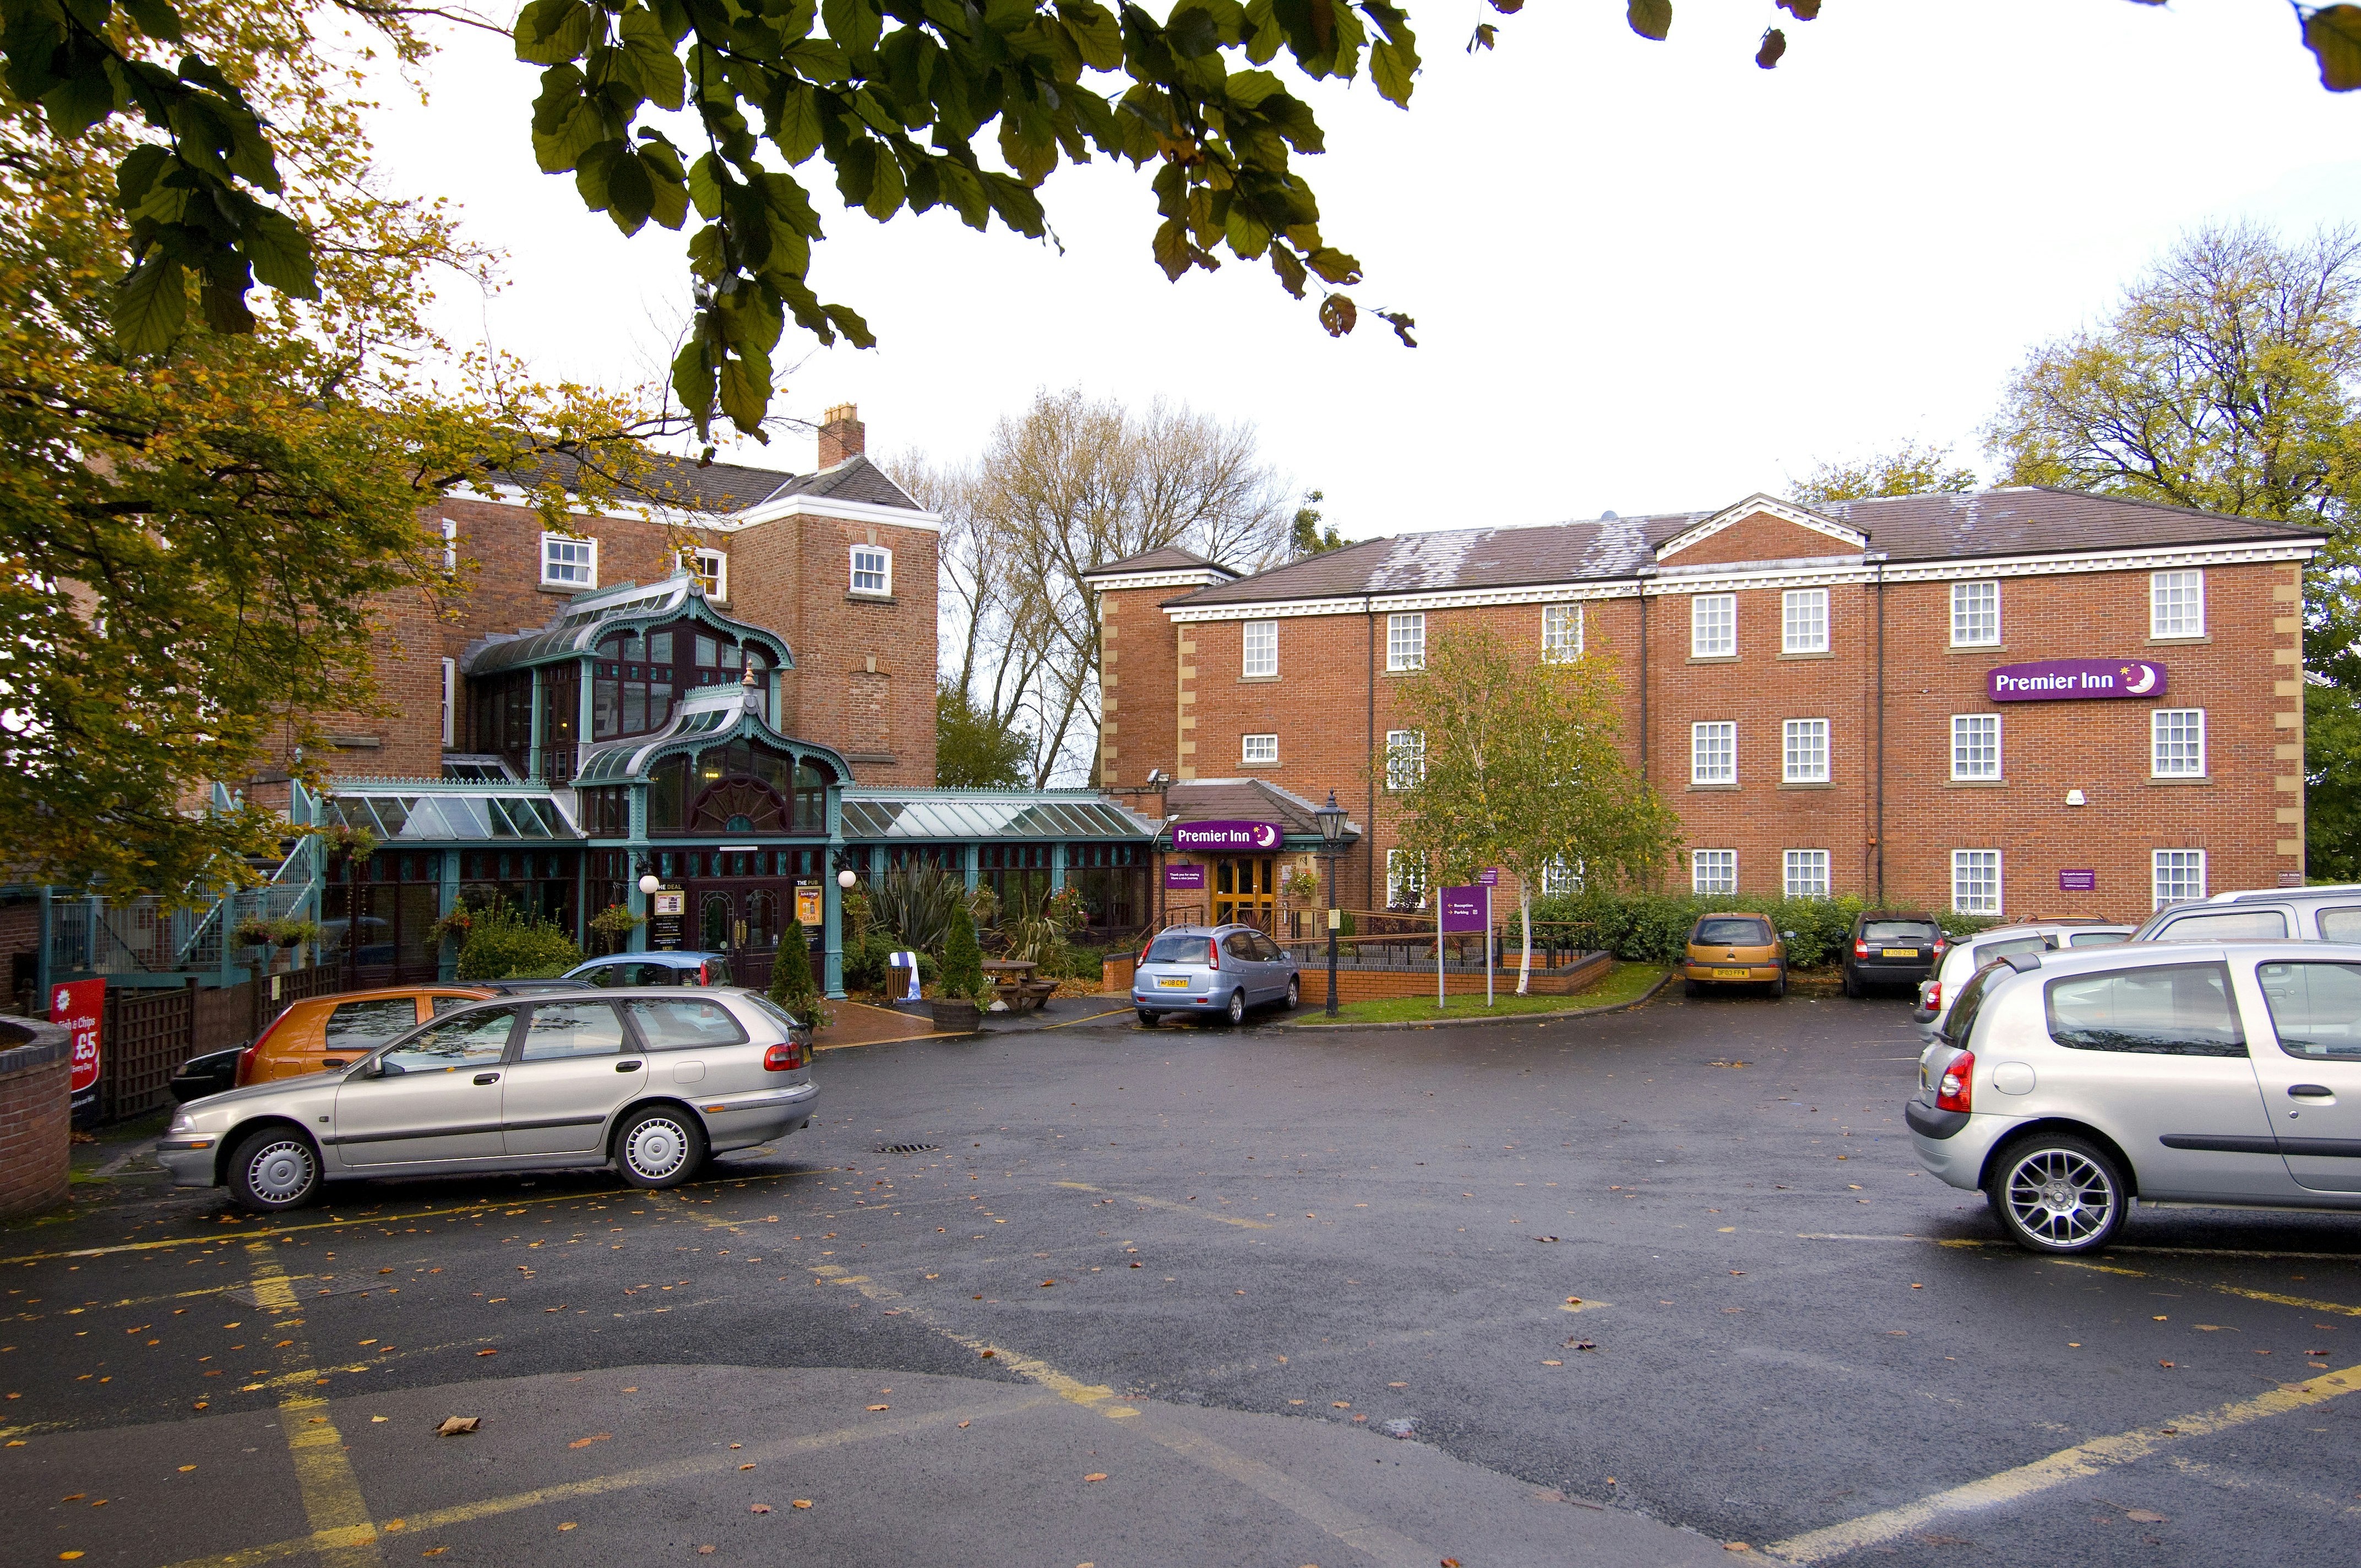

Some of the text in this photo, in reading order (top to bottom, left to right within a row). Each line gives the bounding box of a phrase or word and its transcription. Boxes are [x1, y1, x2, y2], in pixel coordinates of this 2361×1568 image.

[1996, 672, 2114, 691] Premier Inn
[1178, 830, 1250, 842] Premier Inn
[73, 1020, 77, 1030] &
[78, 1016, 96, 1030] Chips
[75, 1031, 97, 1060] £5
[84, 1062, 93, 1071] Day
